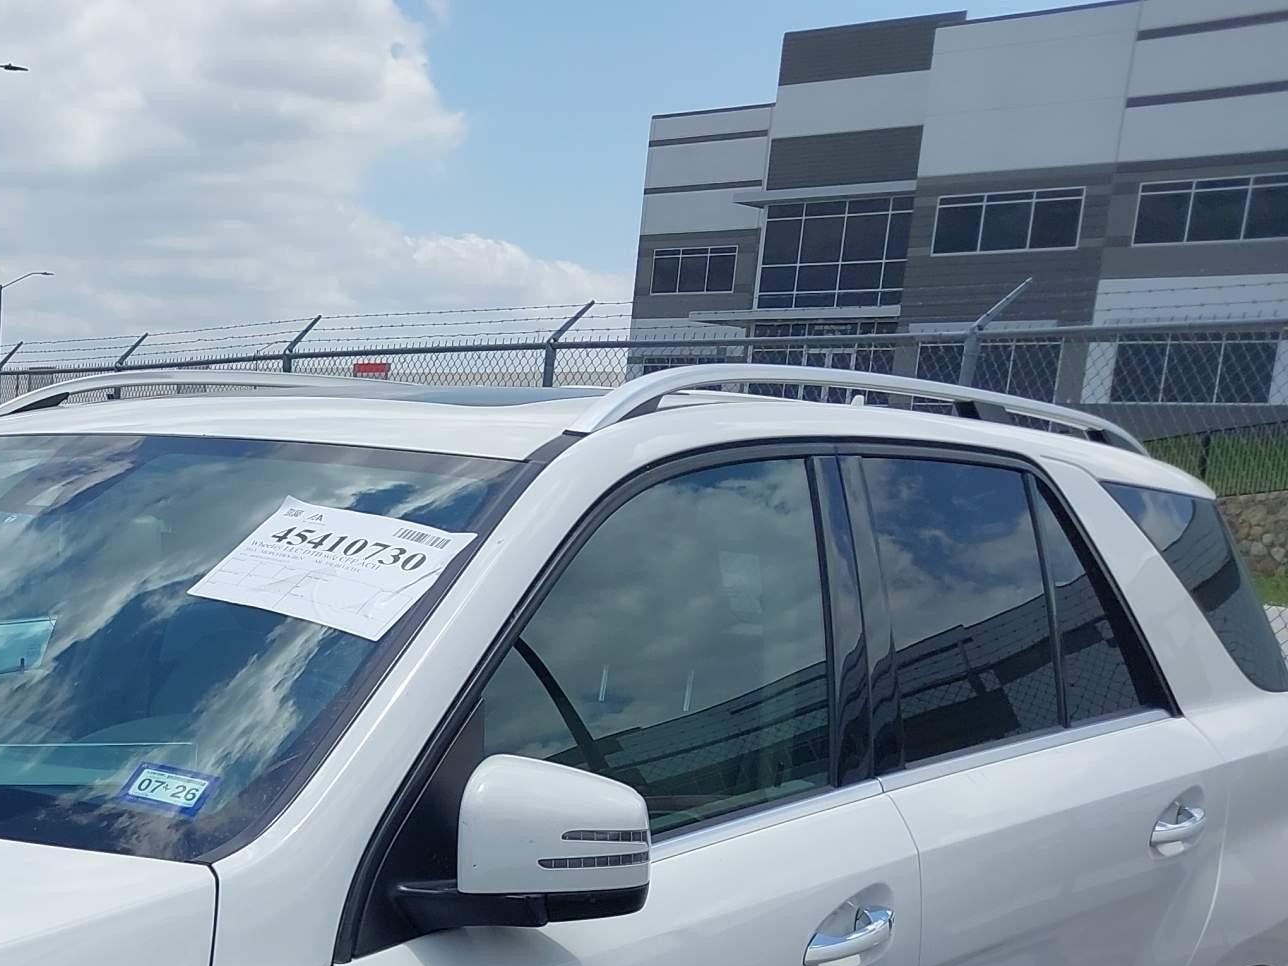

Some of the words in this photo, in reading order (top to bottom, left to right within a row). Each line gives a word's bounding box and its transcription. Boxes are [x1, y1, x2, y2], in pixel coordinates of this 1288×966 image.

[271, 526, 427, 572] 45410730
[137, 778, 166, 793] 07
[170, 784, 200, 802] 26
